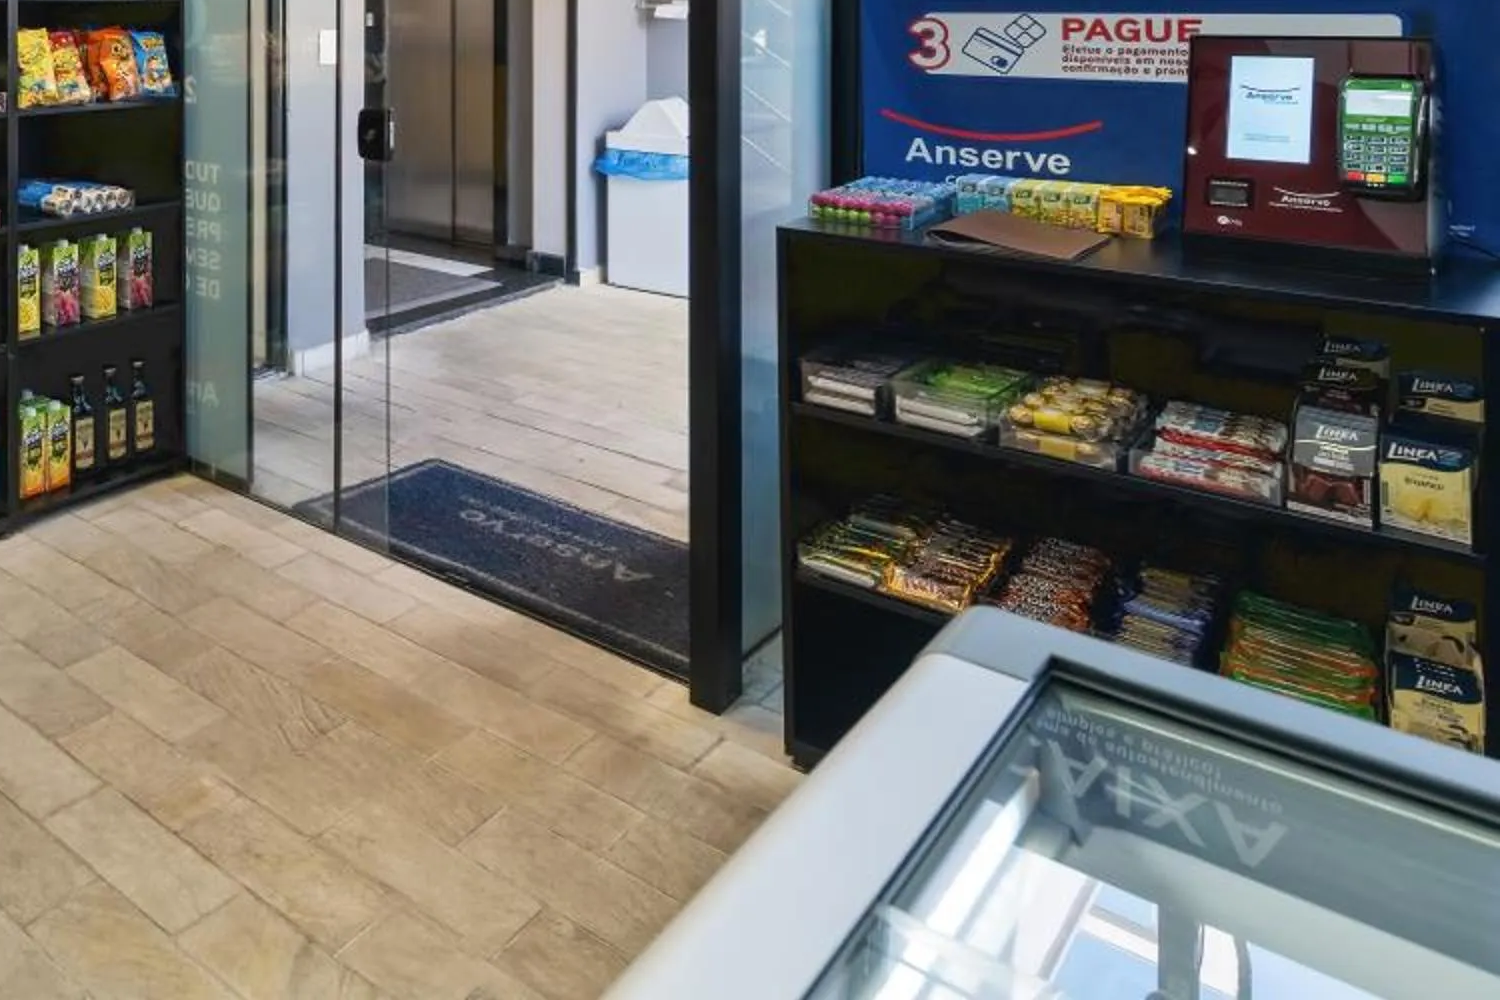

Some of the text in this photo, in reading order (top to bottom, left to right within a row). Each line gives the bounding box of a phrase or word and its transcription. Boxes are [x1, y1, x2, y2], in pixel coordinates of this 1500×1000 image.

[1061, 17, 1203, 43] PAGUE
[908, 16, 952, 71] 3
[1117, 46, 1189, 58] pagamento
[1061, 64, 1139, 77] confirmação
[1245, 90, 1293, 102] Anserve
[905, 137, 1072, 175] Anserve
[1315, 424, 1360, 442] LINEA
[1387, 442, 1439, 462] LINEA
[1411, 595, 1454, 615] LINEA
[1416, 674, 1464, 696] LINEA
